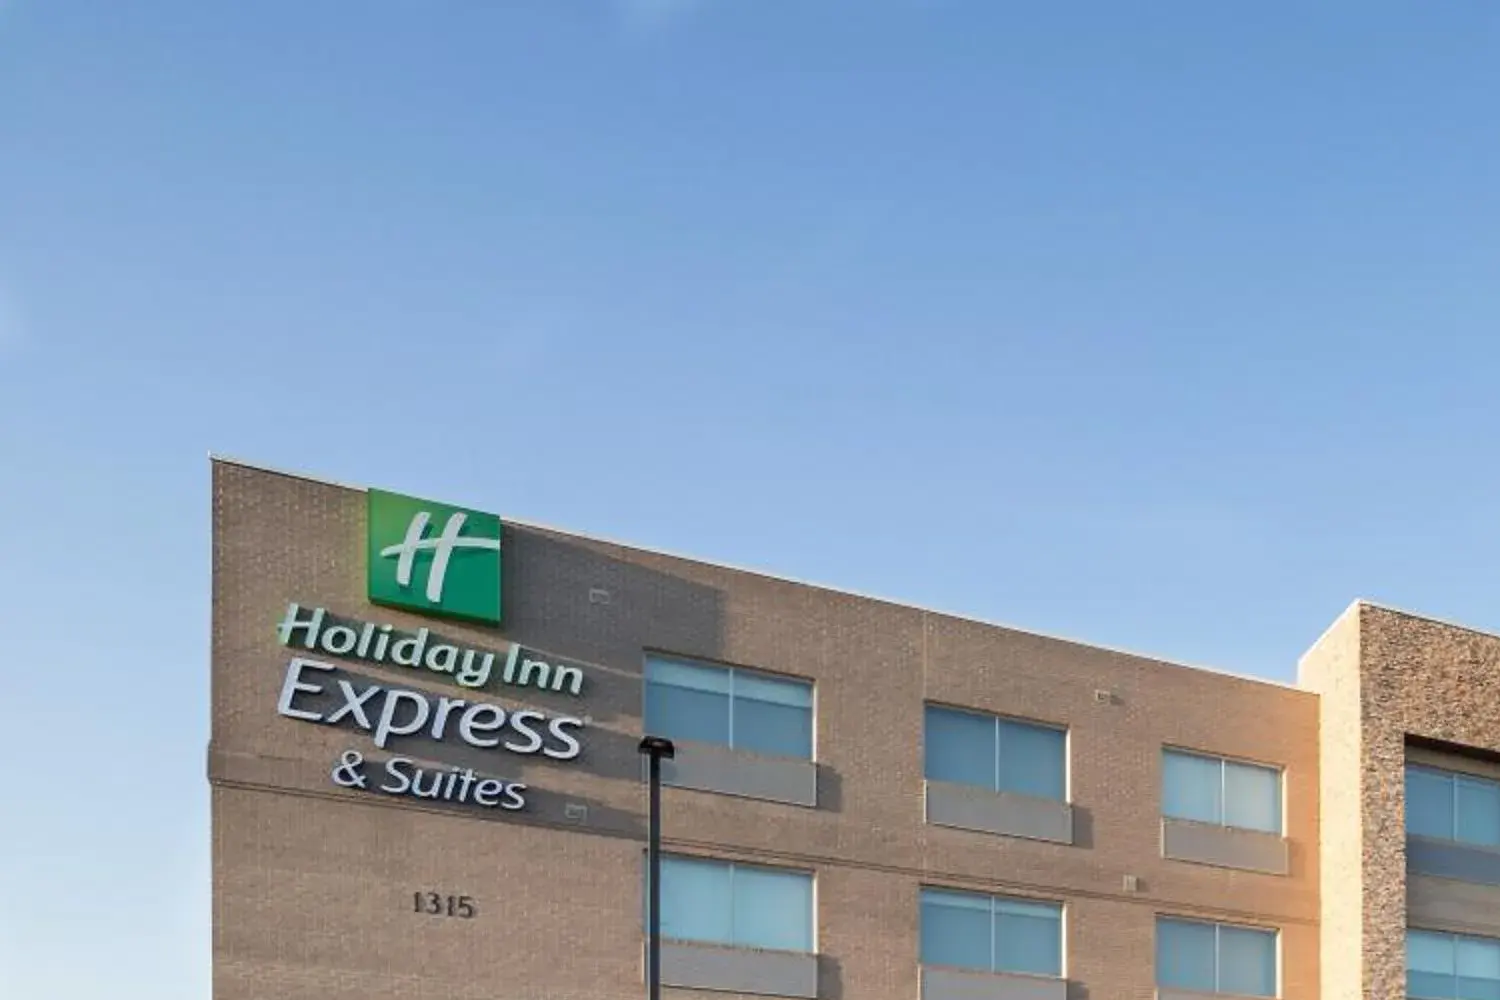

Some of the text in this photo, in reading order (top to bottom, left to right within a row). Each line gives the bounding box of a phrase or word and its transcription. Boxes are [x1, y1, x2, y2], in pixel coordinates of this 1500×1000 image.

[278, 603, 583, 695] Holiday Inn
[277, 656, 583, 760] Express
[330, 749, 526, 810] & Suites
[412, 891, 475, 919] 1315
